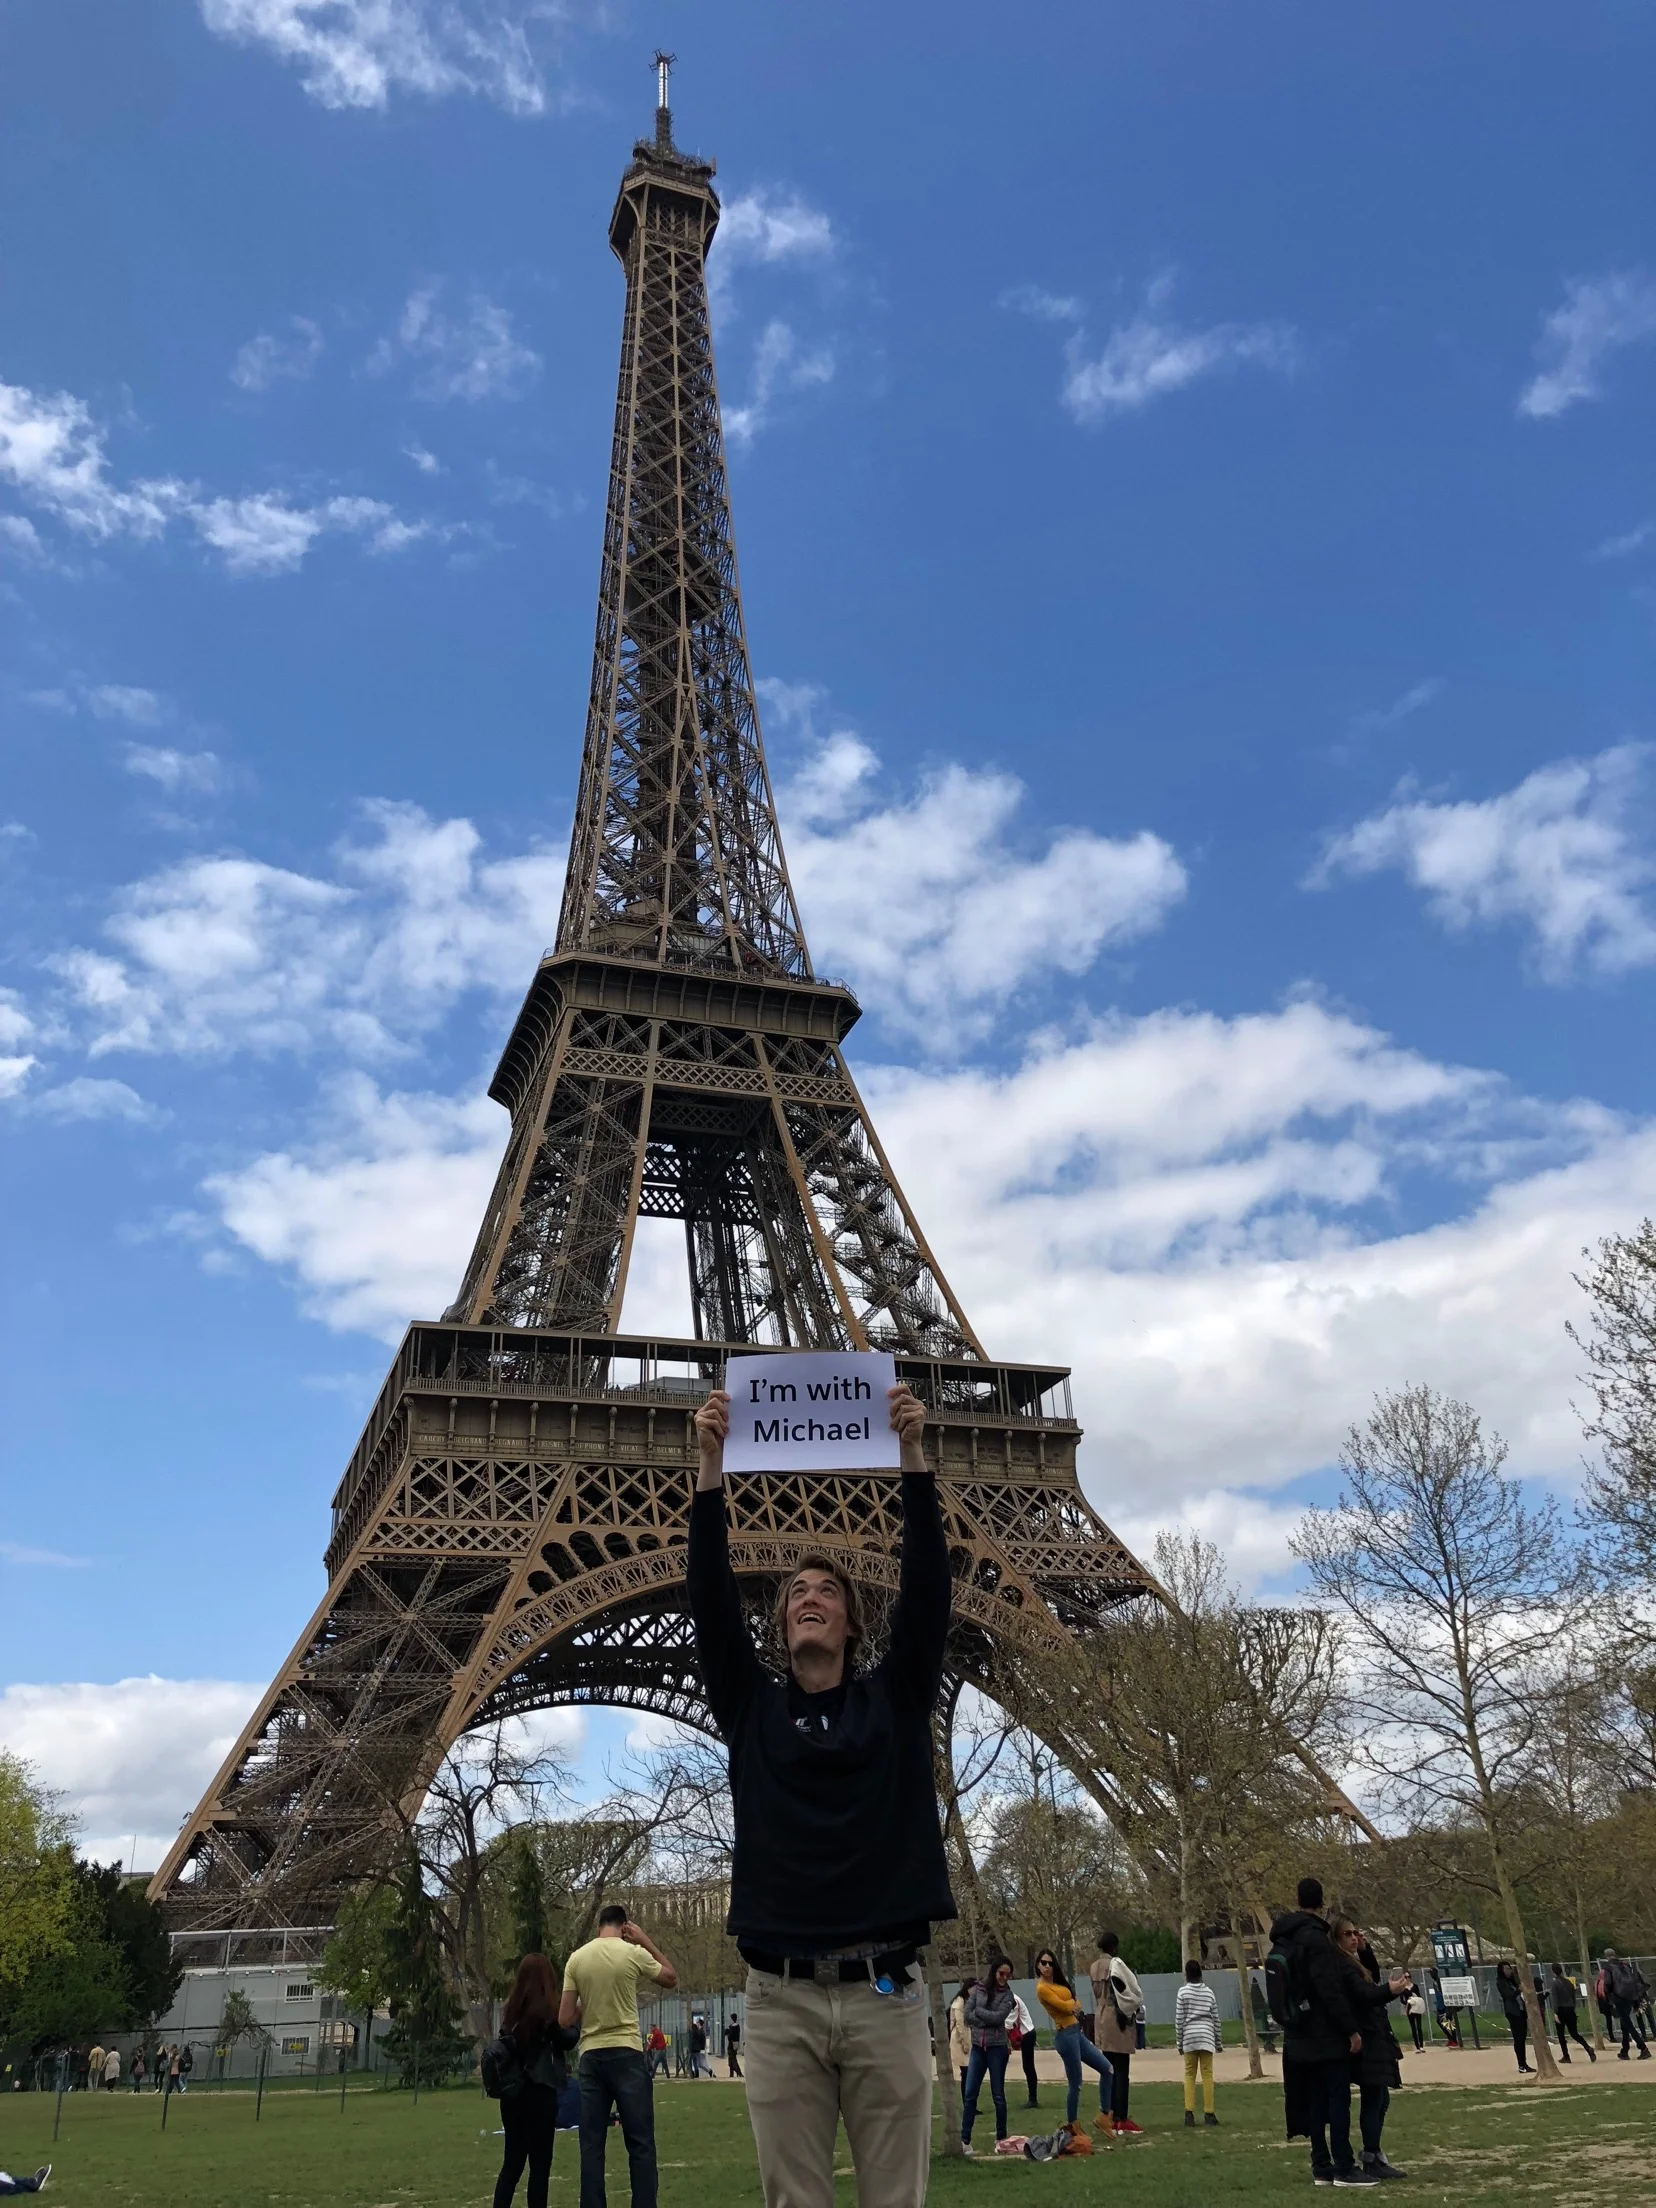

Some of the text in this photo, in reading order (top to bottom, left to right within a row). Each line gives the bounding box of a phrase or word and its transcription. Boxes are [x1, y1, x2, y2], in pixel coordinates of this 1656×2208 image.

[750, 1375, 871, 1403] I'm with
[754, 1417, 870, 1443] Michael
[419, 1435, 445, 1443] CAUCHY
[453, 1436, 487, 1445] BELGRAND
[537, 1440, 564, 1448] FRESNEL
